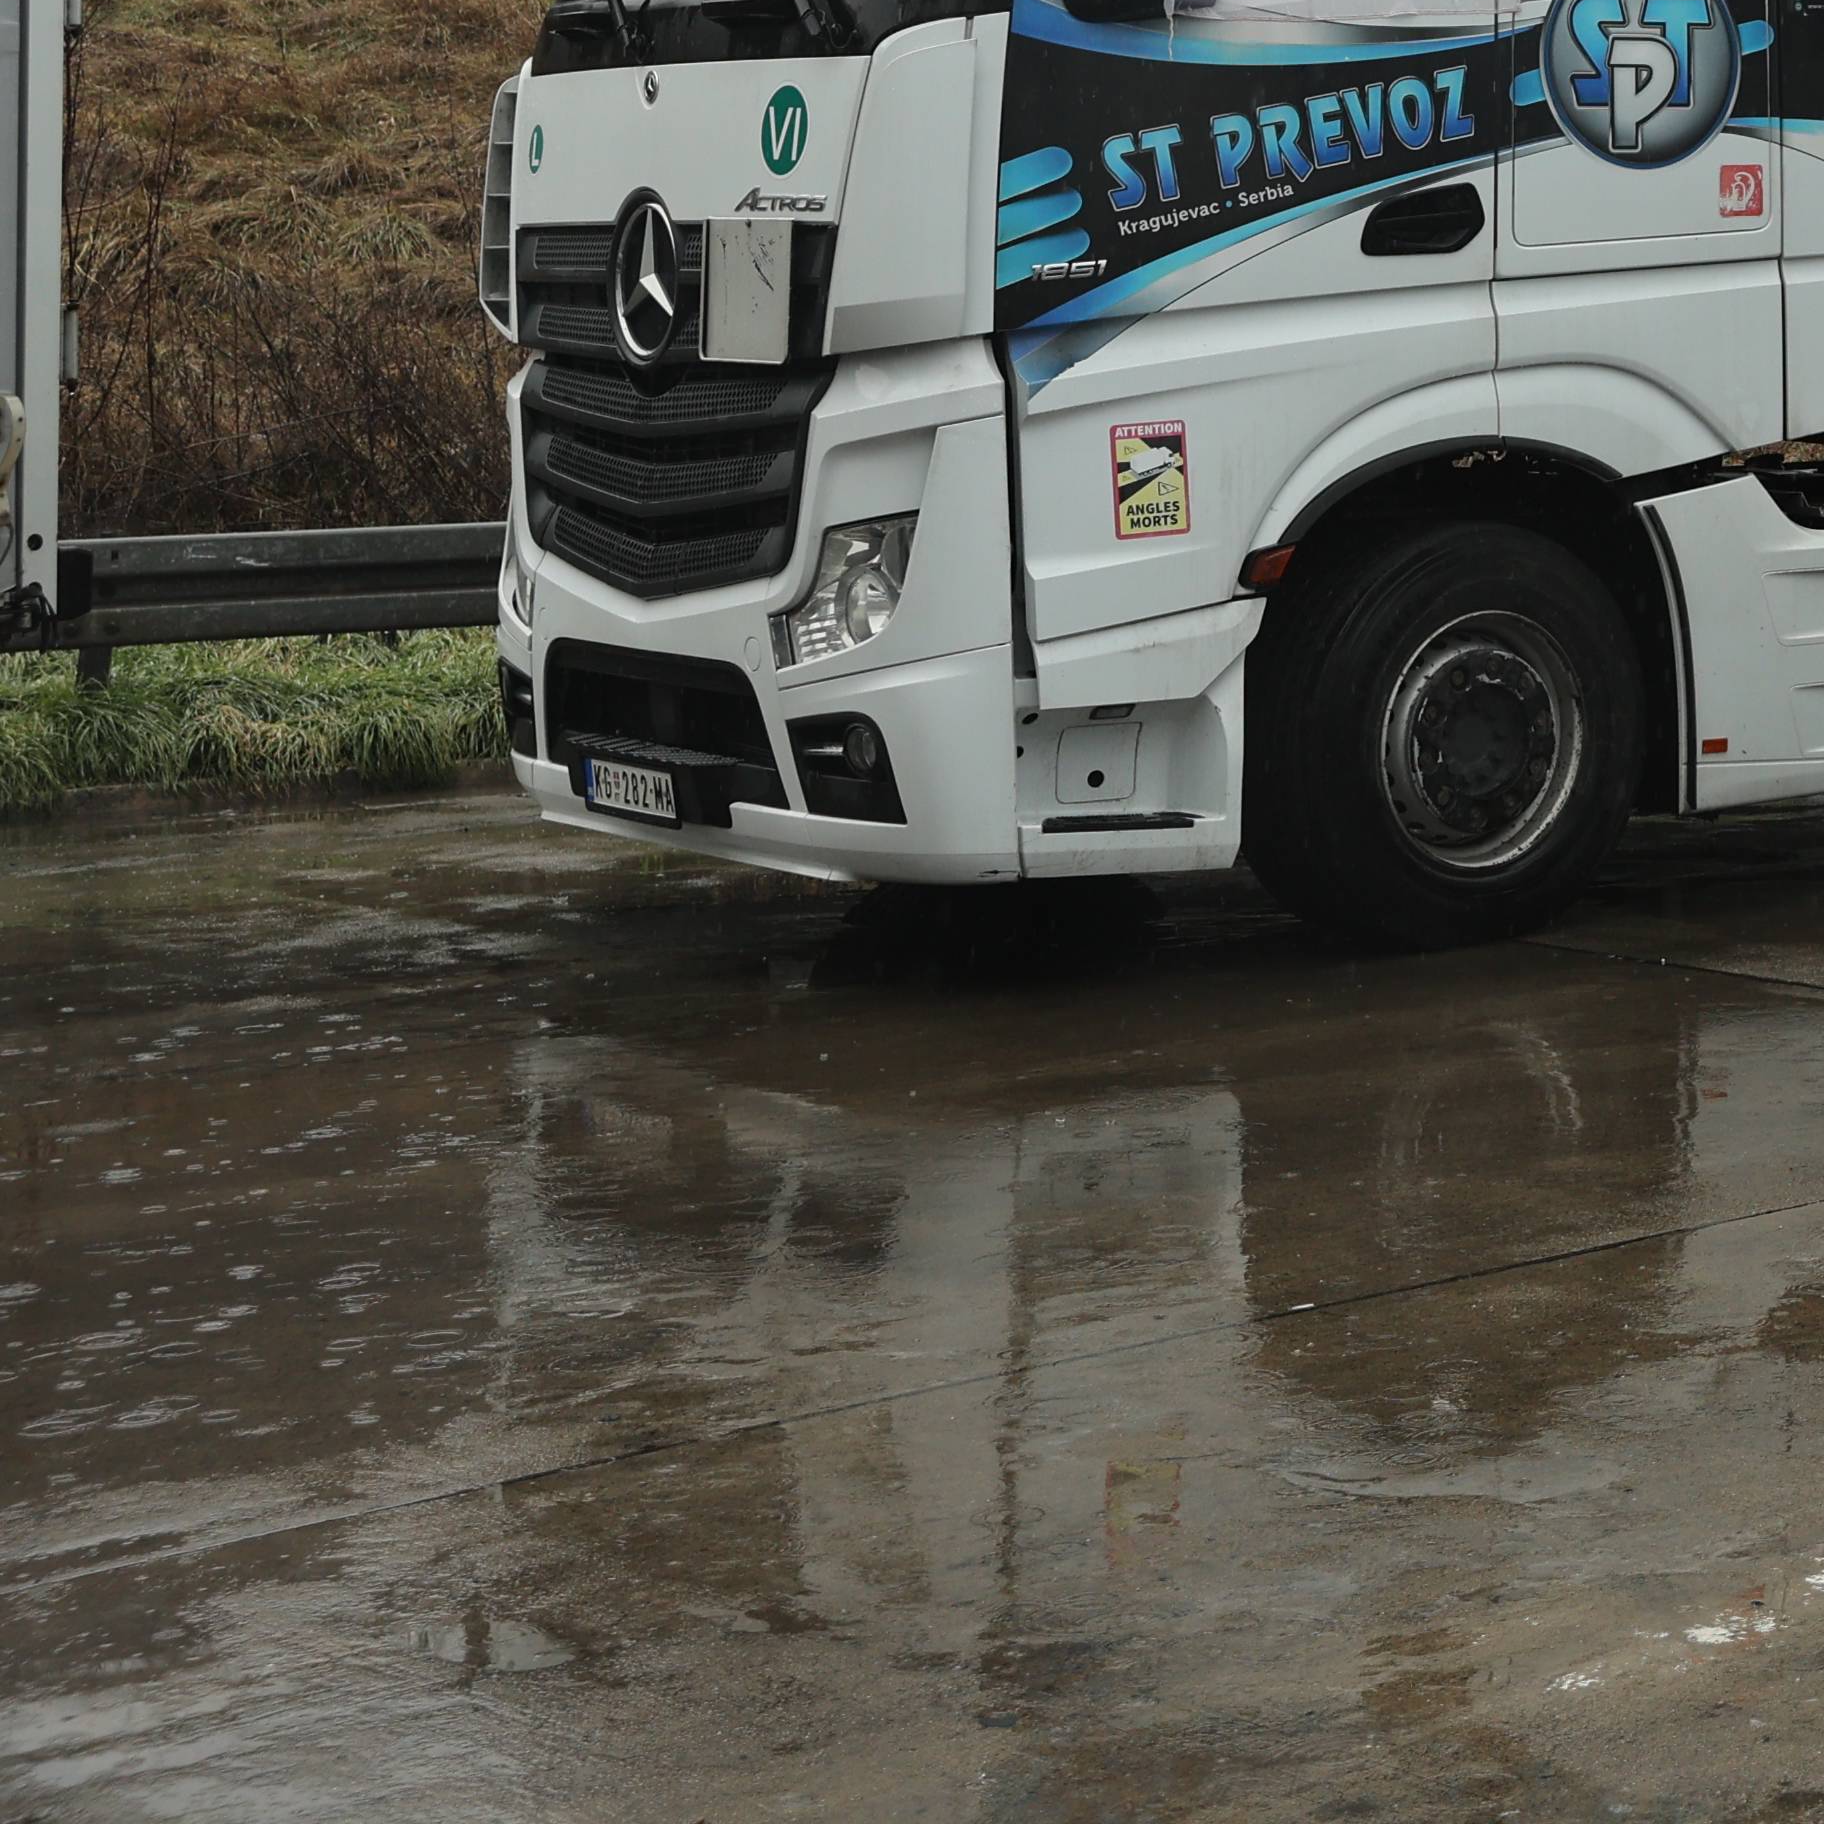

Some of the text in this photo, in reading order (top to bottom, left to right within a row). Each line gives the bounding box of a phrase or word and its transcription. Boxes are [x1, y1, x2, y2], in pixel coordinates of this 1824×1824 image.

[768, 105, 802, 162] VI
[1102, 64, 1476, 212] ST PREVOZ
[1117, 182, 1295, 237] Kragujevac Serbia
[1031, 259, 1108, 282] 1851
[1115, 422, 1183, 438] ATTENTION
[1126, 500, 1181, 516] ANGLES
[1130, 513, 1179, 529] MORTS
[593, 763, 612, 800] KG
